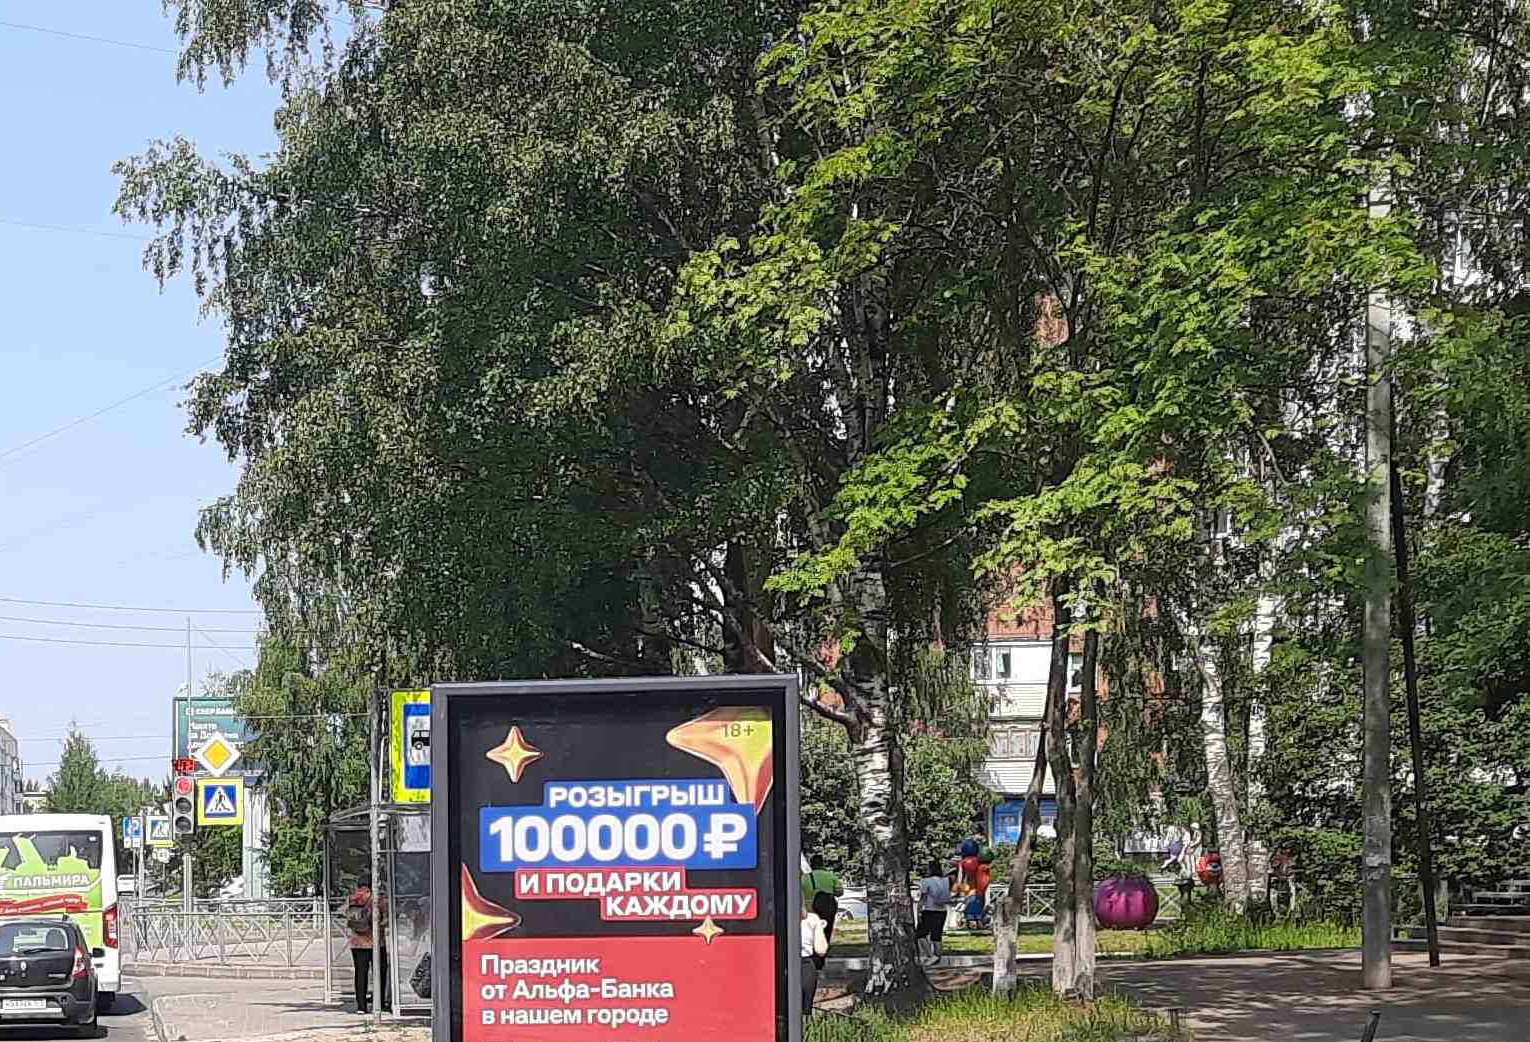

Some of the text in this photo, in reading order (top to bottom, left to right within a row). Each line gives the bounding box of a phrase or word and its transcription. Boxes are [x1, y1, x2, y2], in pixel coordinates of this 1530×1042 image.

[720, 723, 755, 737] 18+
[549, 785, 724, 808] РОЗЫГРЫШ
[13, 874, 90, 889] ПАЛЬМИРА
[520, 871, 681, 896] И ПОДАРКИ
[605, 894, 753, 919] КАЖДОМУ
[480, 954, 600, 978] Праздник
[480, 978, 675, 1003] от Альфа-Банка
[481, 1008, 669, 1029] в нашем городе
